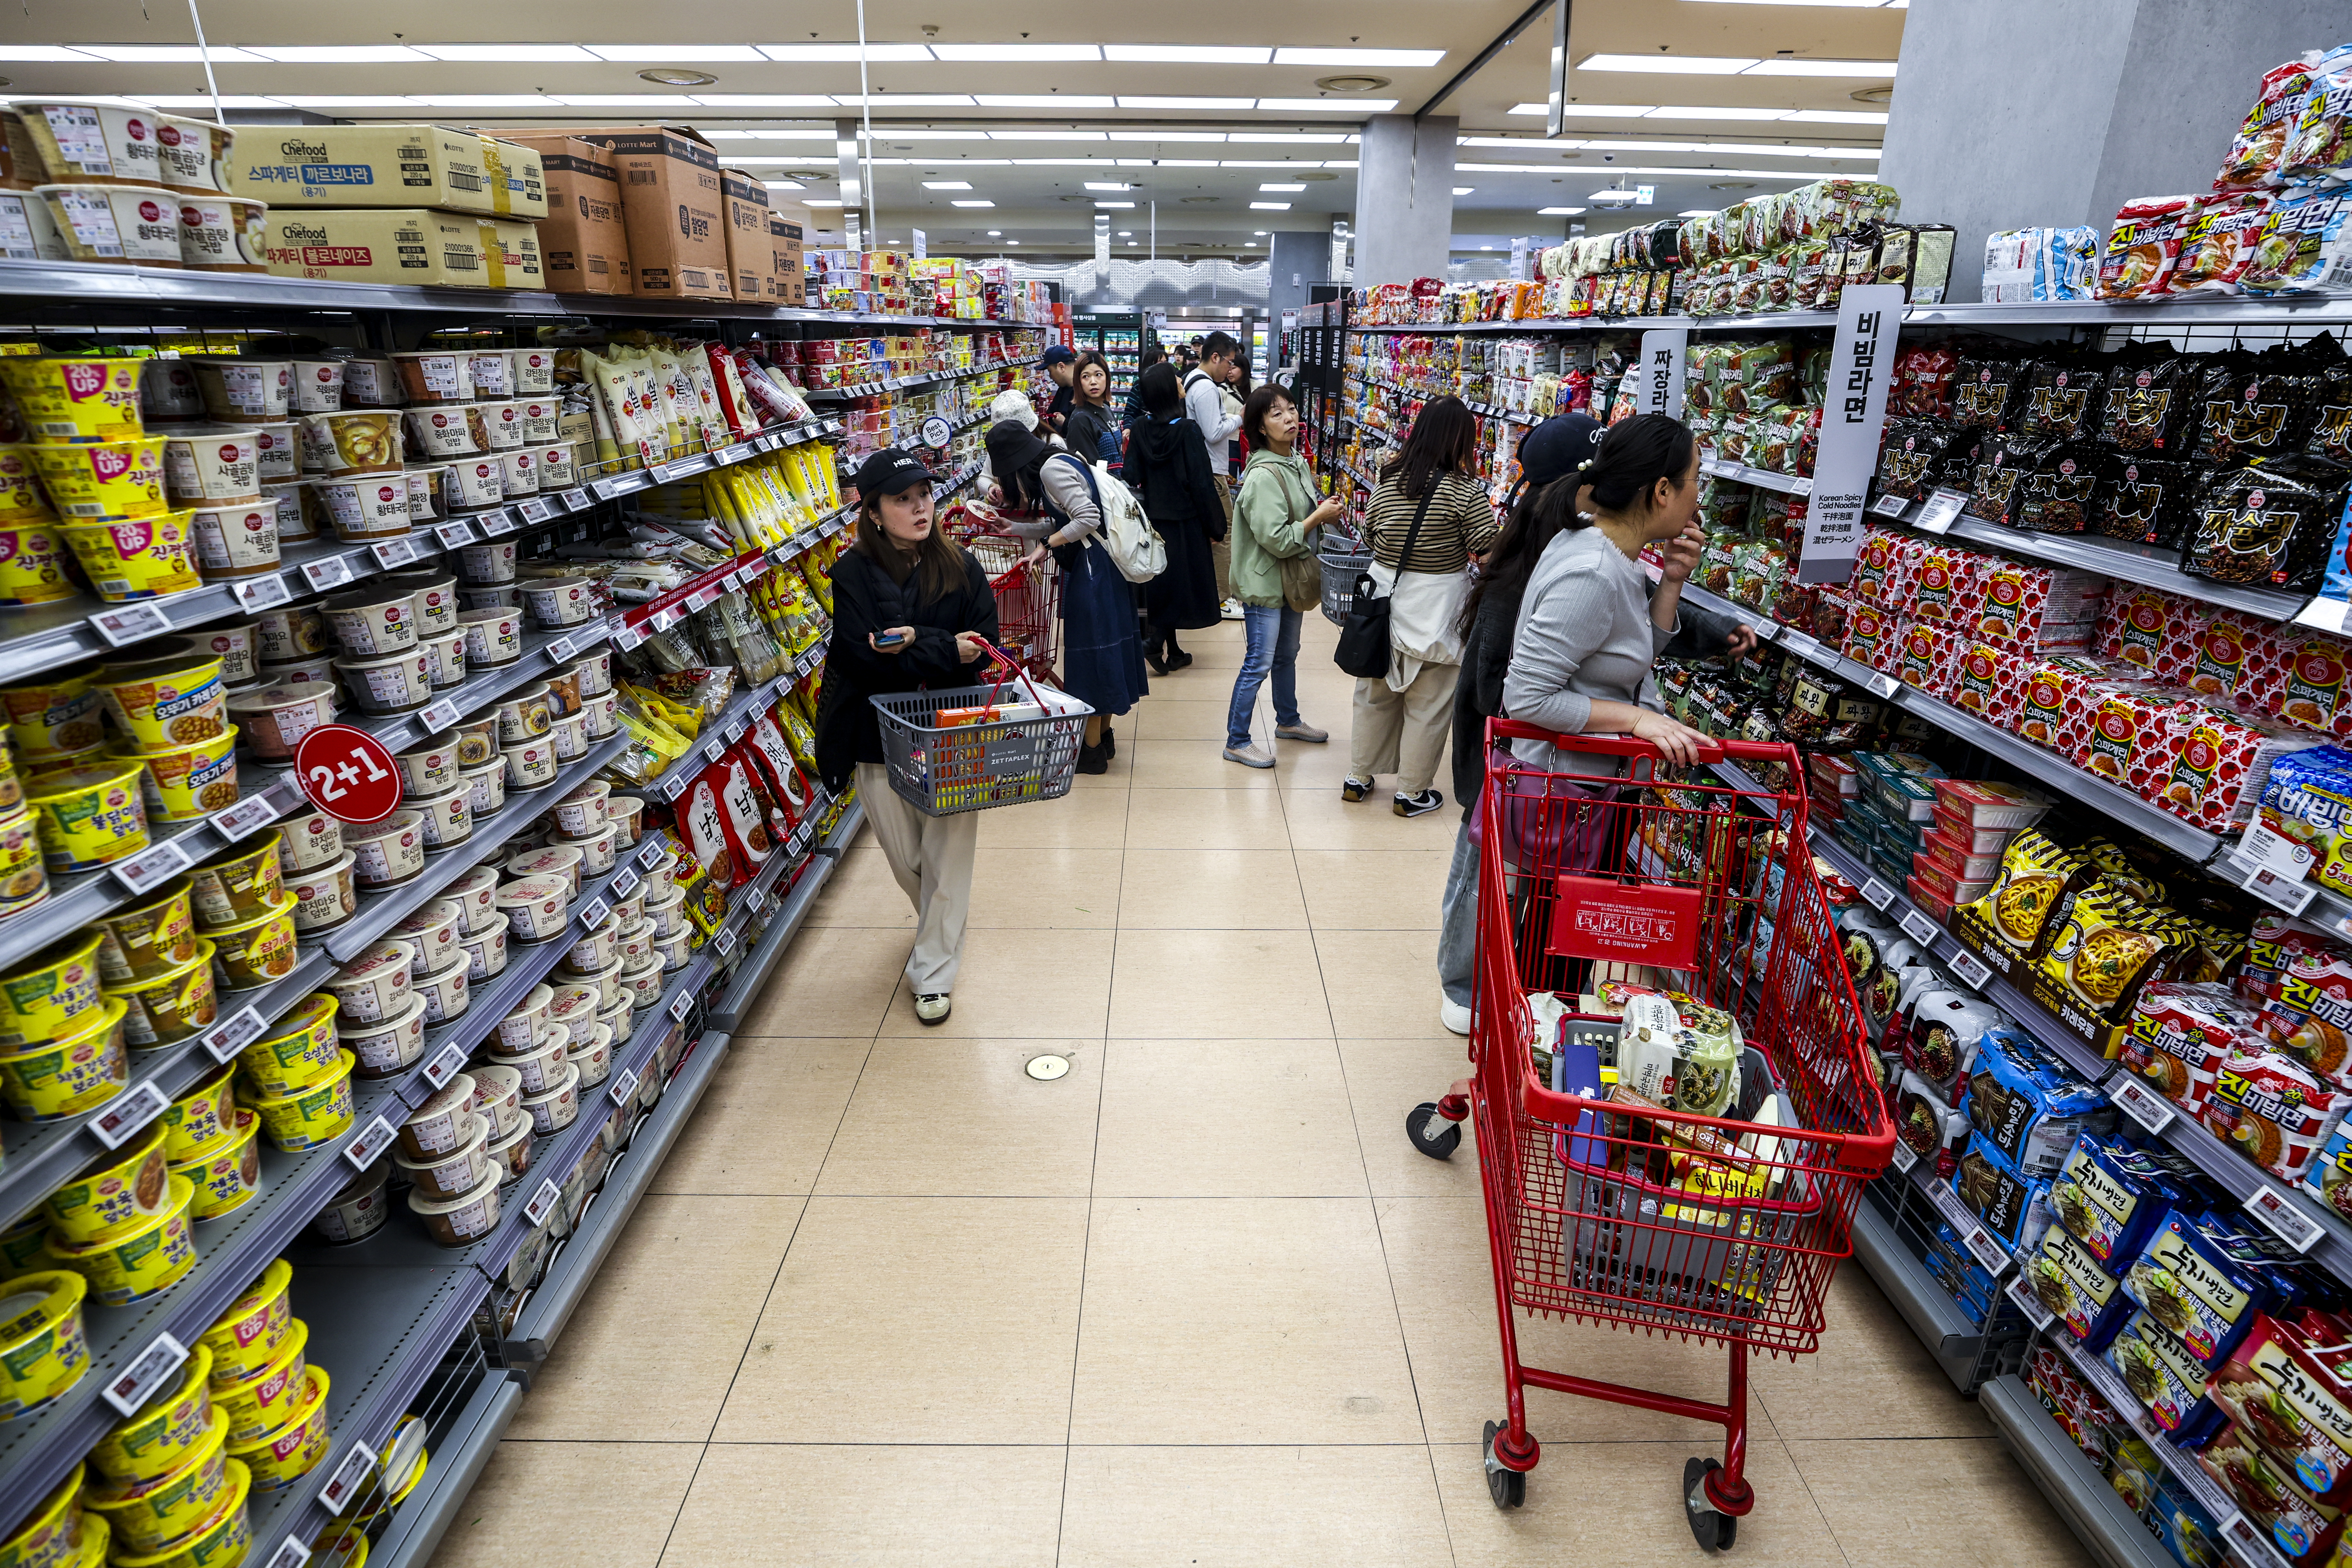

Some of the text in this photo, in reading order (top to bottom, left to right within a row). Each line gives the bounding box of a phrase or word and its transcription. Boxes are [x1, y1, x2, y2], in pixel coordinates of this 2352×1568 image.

[282, 140, 327, 156] Chefood
[173, 163, 197, 177] 국밥
[249, 165, 369, 183] 스파게티 까르보나라
[449, 162, 478, 174] 510001367
[301, 187, 327, 198] (용기)
[590, 205, 610, 220] 자른당면
[2260, 196, 2340, 240] 진밀면
[283, 225, 327, 239] Chefood
[2191, 208, 2261, 241] 진비빔면
[2109, 218, 2178, 252] 진비빔면
[199, 241, 222, 254] 국밥
[445, 243, 474, 253] 510001366
[267, 249, 300, 265] 파게티
[779, 258, 795, 272] 자른당면
[1847, 257, 1865, 271] 짜왕
[303, 268, 327, 278] (용기)
[1795, 264, 1824, 278] 짜파게티
[1755, 361, 1794, 381] 짜파게티
[1843, 310, 1881, 424] 비빔라면
[71, 379, 99, 392] UP
[533, 376, 548, 385] 비빔밥
[1719, 369, 1744, 385] 짜파게티
[1957, 382, 2008, 416] 짜슐랭
[2031, 387, 2087, 424] 짜슐랭
[2106, 388, 2171, 427] 짜슐랭
[525, 417, 555, 427] 강된장보리
[533, 425, 550, 433] 비빔밥
[925, 422, 942, 435] Best
[1766, 421, 1792, 441] 짜파게티
[2206, 401, 2287, 446] 짜슐랭
[434, 429, 466, 437] 중화마파
[445, 437, 461, 447] 덮밥
[929, 429, 945, 440] Pick
[218, 464, 254, 478] 사골곰탕
[552, 470, 568, 478] 비빔밥
[1883, 450, 1931, 482] 짜슐랭
[231, 476, 250, 486] 국밥
[2030, 474, 2095, 503] 짜슐랭
[486, 487, 498, 496] 덮밥
[1844, 494, 1863, 503] Spicy
[376, 502, 407, 515] 황태국밥
[1822, 511, 1853, 521] 干拌泡面
[1820, 524, 1851, 532] 乾拌泡麵
[2198, 510, 2300, 556] 짜슐랭
[121, 537, 146, 549] UP
[257, 542, 274, 554] 국밥
[1813, 536, 1855, 545] 混ぜラーメン
[1708, 547, 1734, 566] 짜파게티
[1744, 557, 1770, 579] 짜파게티
[1920, 589, 1948, 602] 스파게티
[426, 602, 453, 617] 스팸마요
[435, 612, 449, 624] 덮밥
[1985, 603, 2016, 620] 스파게티
[385, 618, 414, 633] 스팸마요
[396, 630, 410, 641] 덮밥
[2126, 628, 2159, 648] 스파게티
[2201, 659, 2235, 681] 스파게티
[1965, 672, 1992, 692] 스파게티
[1690, 689, 1712, 711] 짜파게티
[1798, 689, 1819, 708] 짜왕
[2290, 684, 2333, 706] 스파게티
[155, 700, 191, 720] 오뚜기
[2027, 705, 2057, 724] 스파게티
[2094, 737, 2128, 759] 스파게티
[991, 754, 1030, 764] ZETTAPLEX
[189, 767, 220, 789] 오뚜기
[309, 746, 389, 802] 2+1
[2176, 764, 2206, 788] 스파게티
[309, 829, 338, 847] 참치마요
[2264, 834, 2276, 843] 비빔면
[321, 841, 336, 854] 덮밥
[298, 894, 336, 910] 참치마요
[1880, 894, 1889, 902] 4,480
[2288, 889, 2304, 900] 4,280
[310, 906, 330, 919] 덮밥
[1982, 942, 2010, 973] 카레우동
[1650, 1005, 1664, 1032] 미역국라면
[1683, 1018, 1691, 1026] 양반
[2033, 990, 2060, 1014] CoCo壱番屋
[2060, 1003, 2096, 1040] 카레우동
[2276, 1004, 2300, 1022] 초시원!
[2132, 1013, 2209, 1067] 진비빔면
[1637, 1063, 1653, 1098] 미역국라면
[1665, 1080, 1674, 1091] 양반
[2136, 1098, 2161, 1118] 3,280 2,952
[2212, 1096, 2233, 1115] 초시원!
[2217, 1071, 2309, 1133] 진비빔면
[1998, 1097, 2024, 1148] 메밀소바
[1699, 1133, 1720, 1146] ZERO
[2074, 1157, 2126, 1212] 둥지냉면
[1989, 1176, 2010, 1230] 메밀소바
[2081, 1195, 2123, 1236] 동치미물냉면
[2047, 1235, 2105, 1293] 둥지냉면
[2161, 1245, 2234, 1308] 둥지냉면
[2061, 1273, 2102, 1316] 동치미물냉면
[2176, 1285, 2231, 1336] 동치미물냉면
[241, 1320, 262, 1341] UP
[2142, 1323, 2206, 1383] 둥지냉면
[2153, 1359, 2196, 1408] 동치미물냉면
[2260, 1357, 2352, 1438] 둥지냉면
[2297, 1416, 2349, 1469] 비빔냉면
[2276, 1481, 2328, 1531] 비빔냉면
